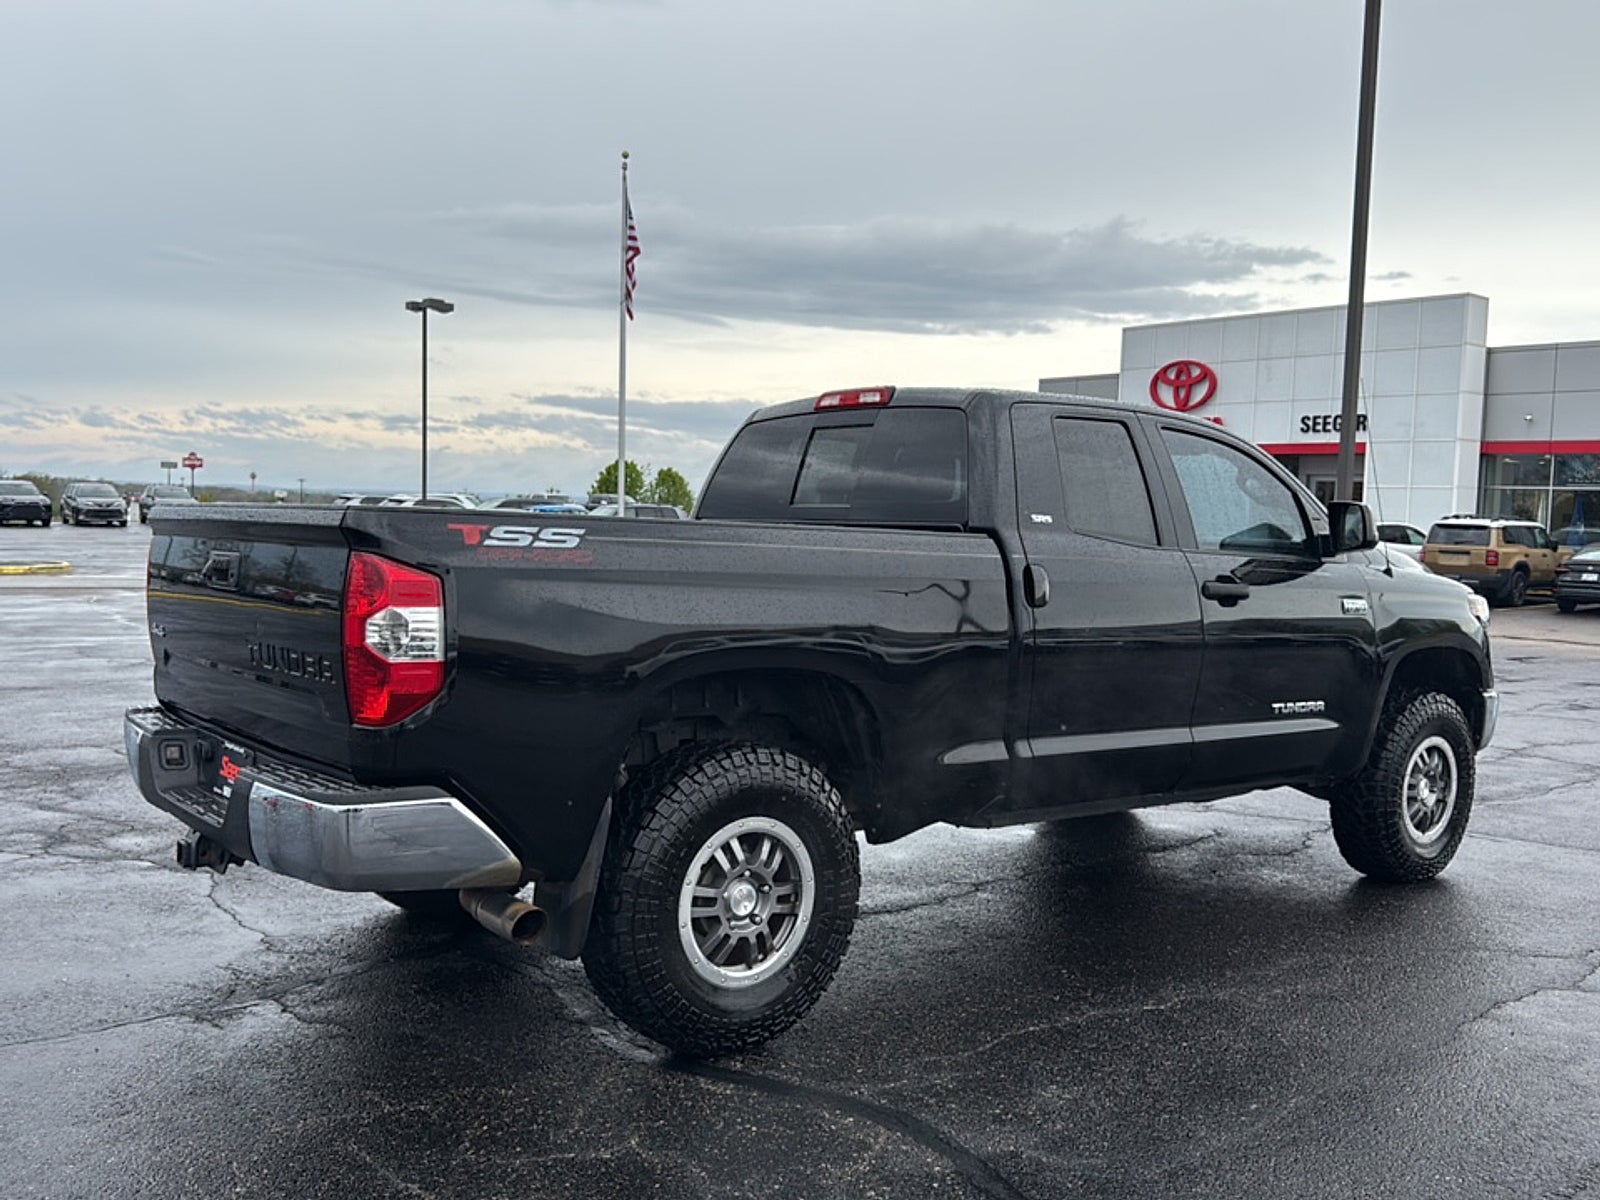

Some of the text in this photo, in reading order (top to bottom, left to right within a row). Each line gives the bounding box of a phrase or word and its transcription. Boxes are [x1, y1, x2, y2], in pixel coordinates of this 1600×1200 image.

[1300, 414, 1368, 433] SEEGR
[447, 523, 586, 548] TSS
[246, 640, 337, 685] TUNDRA
[1271, 700, 1326, 714] TUNDRA
